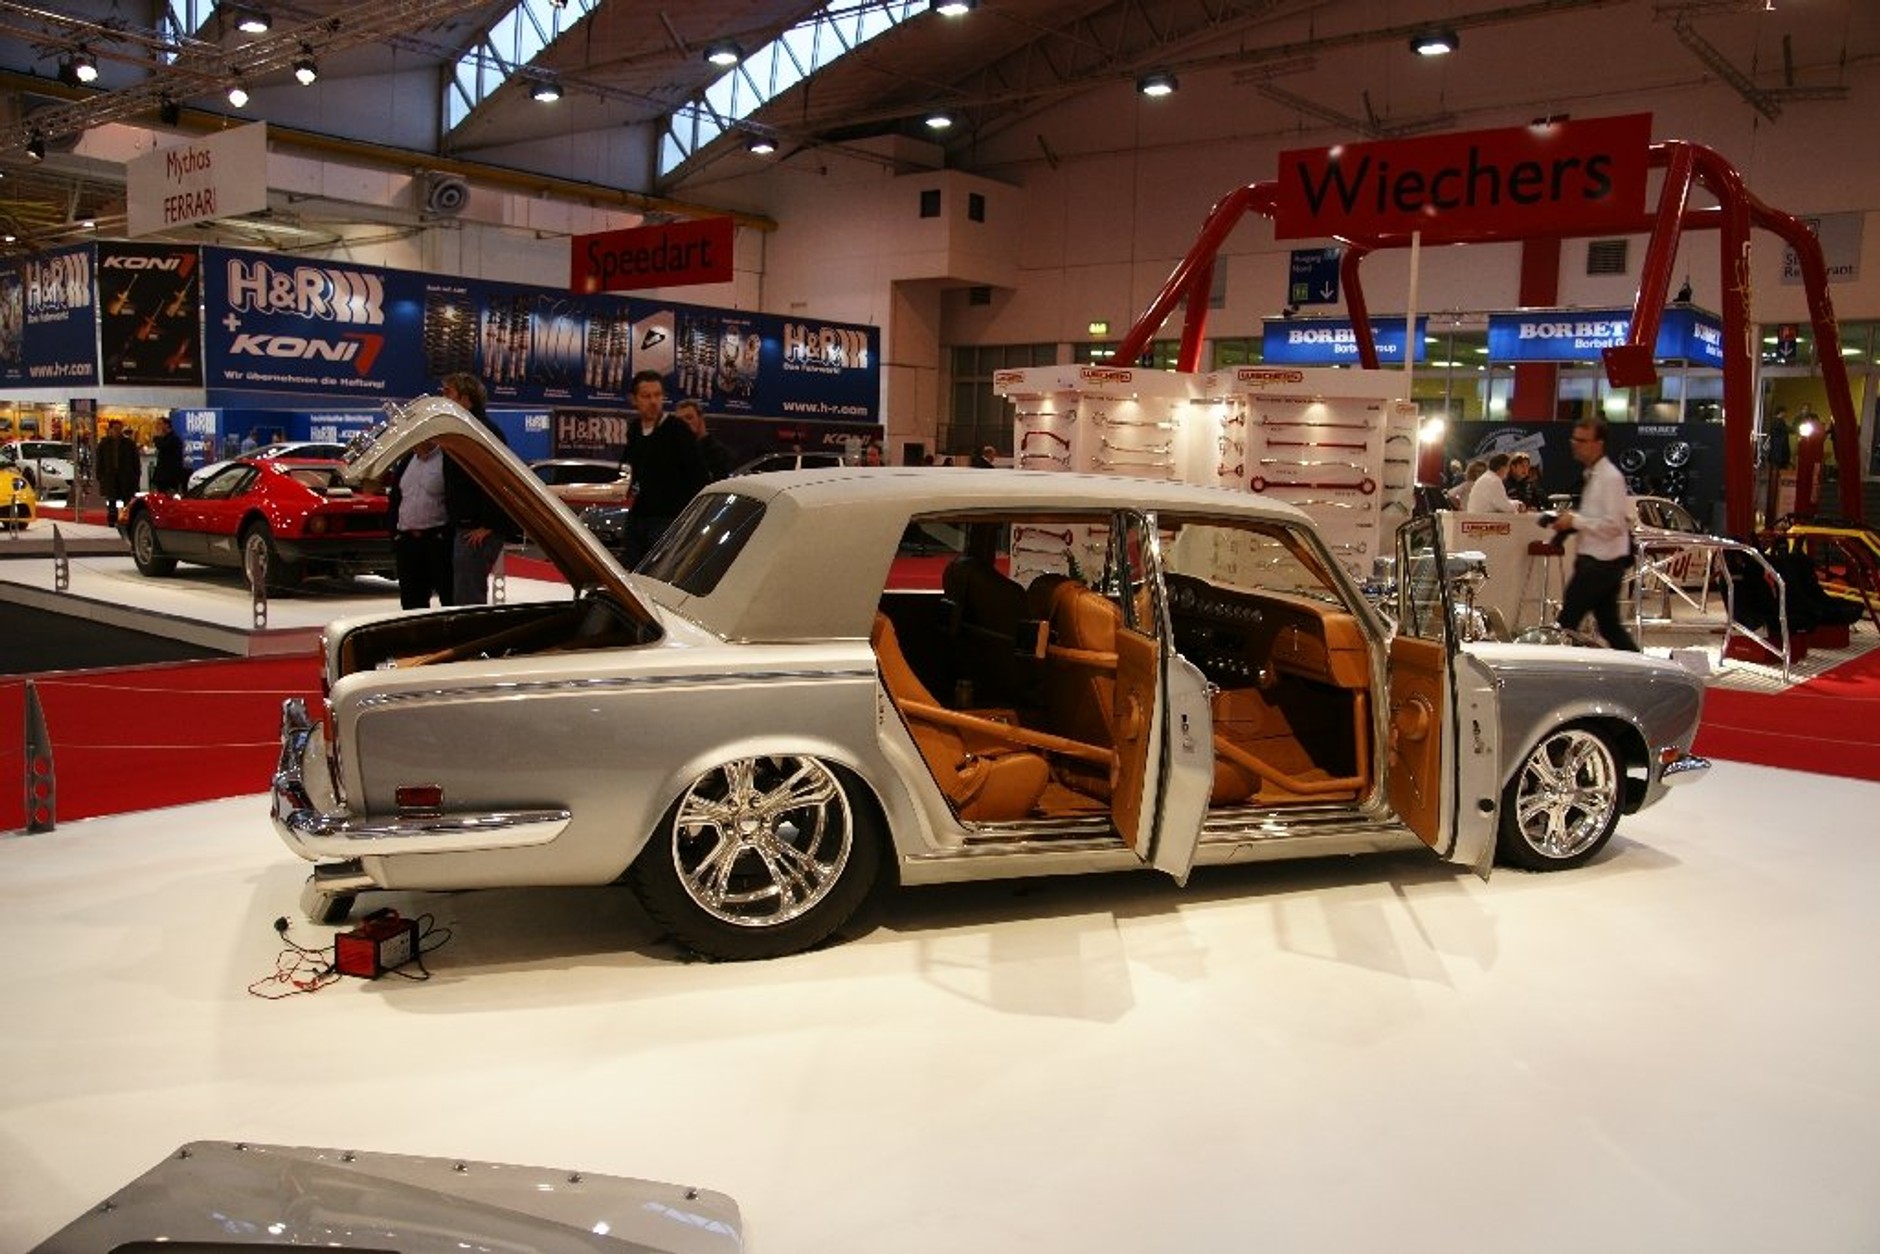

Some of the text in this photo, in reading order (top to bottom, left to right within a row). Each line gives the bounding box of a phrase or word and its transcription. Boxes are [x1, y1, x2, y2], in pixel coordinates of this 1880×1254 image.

[167, 146, 211, 184] Mythos
[1297, 146, 1613, 218] Wiechers
[164, 187, 217, 224] FERRARI
[103, 255, 181, 270] KONI
[587, 233, 712, 291] Speedart
[26, 252, 90, 312] H&R
[228, 258, 385, 325] H&R
[784, 322, 868, 369] H&R
[1519, 321, 1630, 340] BORBET
[229, 333, 359, 362] KONI
[29, 362, 93, 378] www.h-r.com
[224, 371, 243, 380] Wir
[320, 376, 337, 385] die
[783, 401, 868, 416] www.h-r.com
[559, 416, 628, 445] H&R
